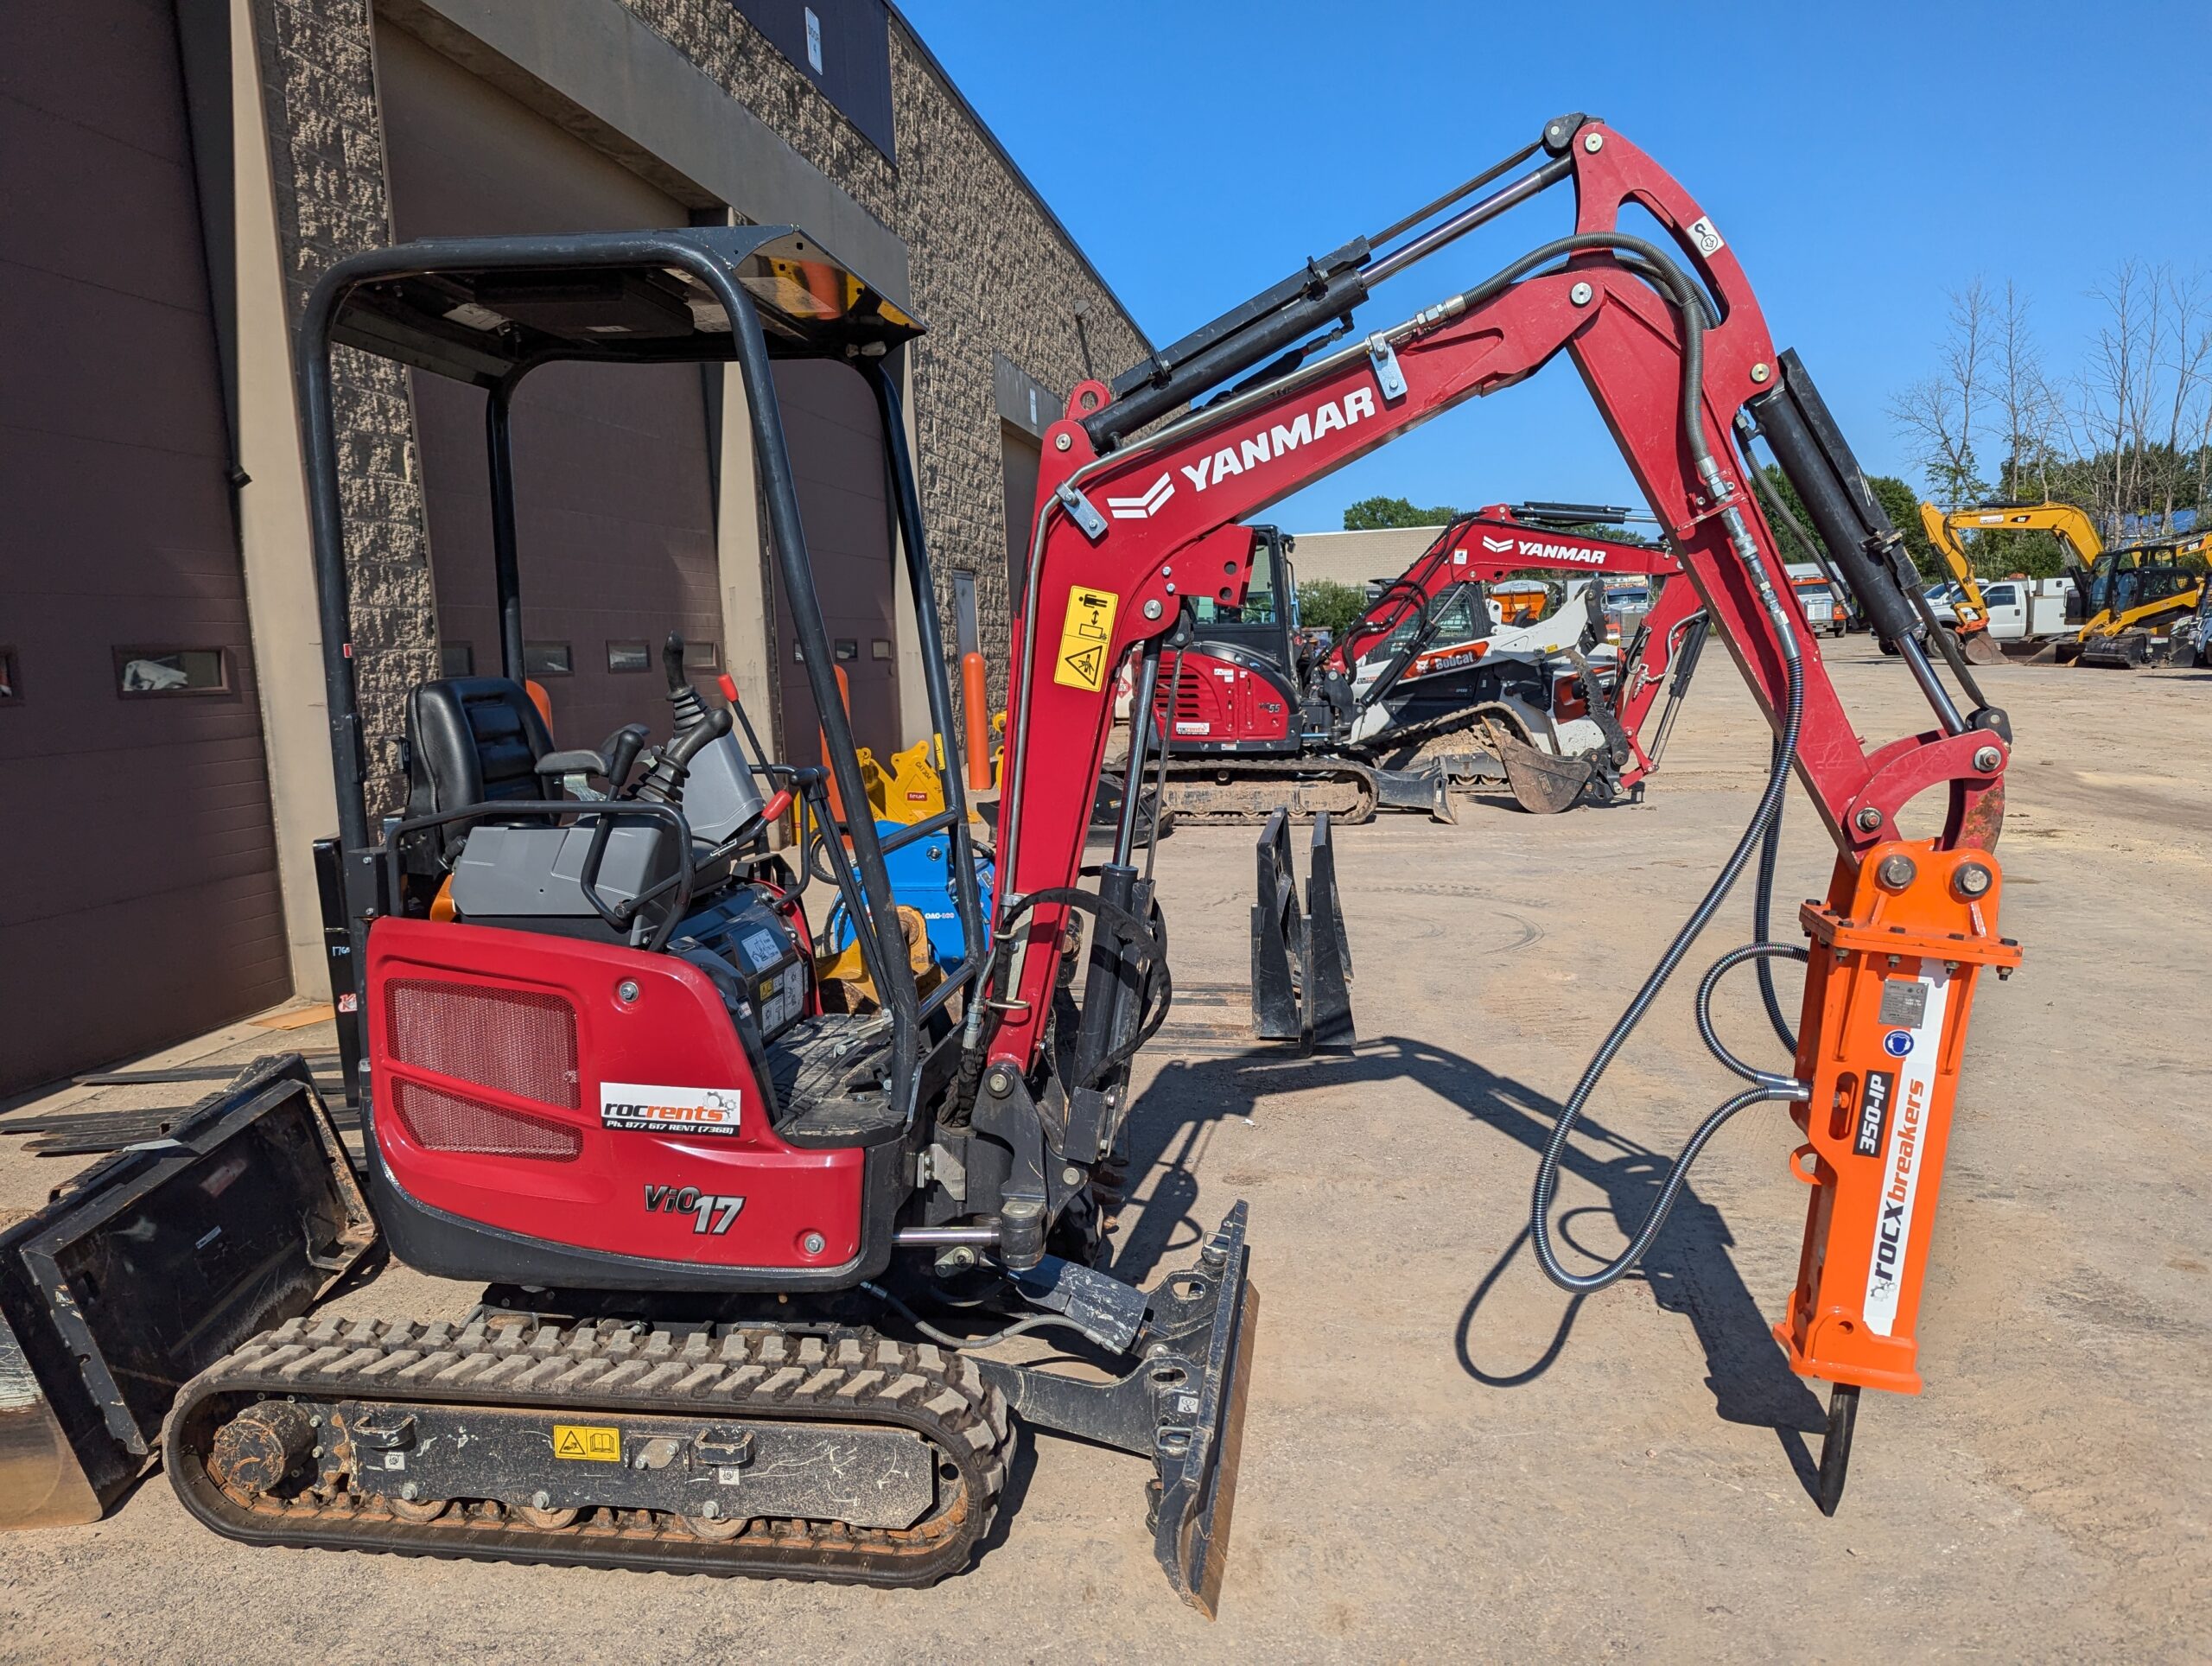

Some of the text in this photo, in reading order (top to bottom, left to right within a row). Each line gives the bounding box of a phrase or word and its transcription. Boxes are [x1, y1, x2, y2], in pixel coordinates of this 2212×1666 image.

[1180, 386, 1376, 493] YANMAR
[1518, 540, 1606, 564] YANMAR
[2188, 542, 2199, 551] CAT
[1434, 651, 1474, 671] Bobcat
[603, 1103, 726, 1122] rocrents
[1859, 1074, 1887, 1155] 350-IP
[625, 1121, 647, 1129] 877
[697, 1126, 734, 1135] (7368)
